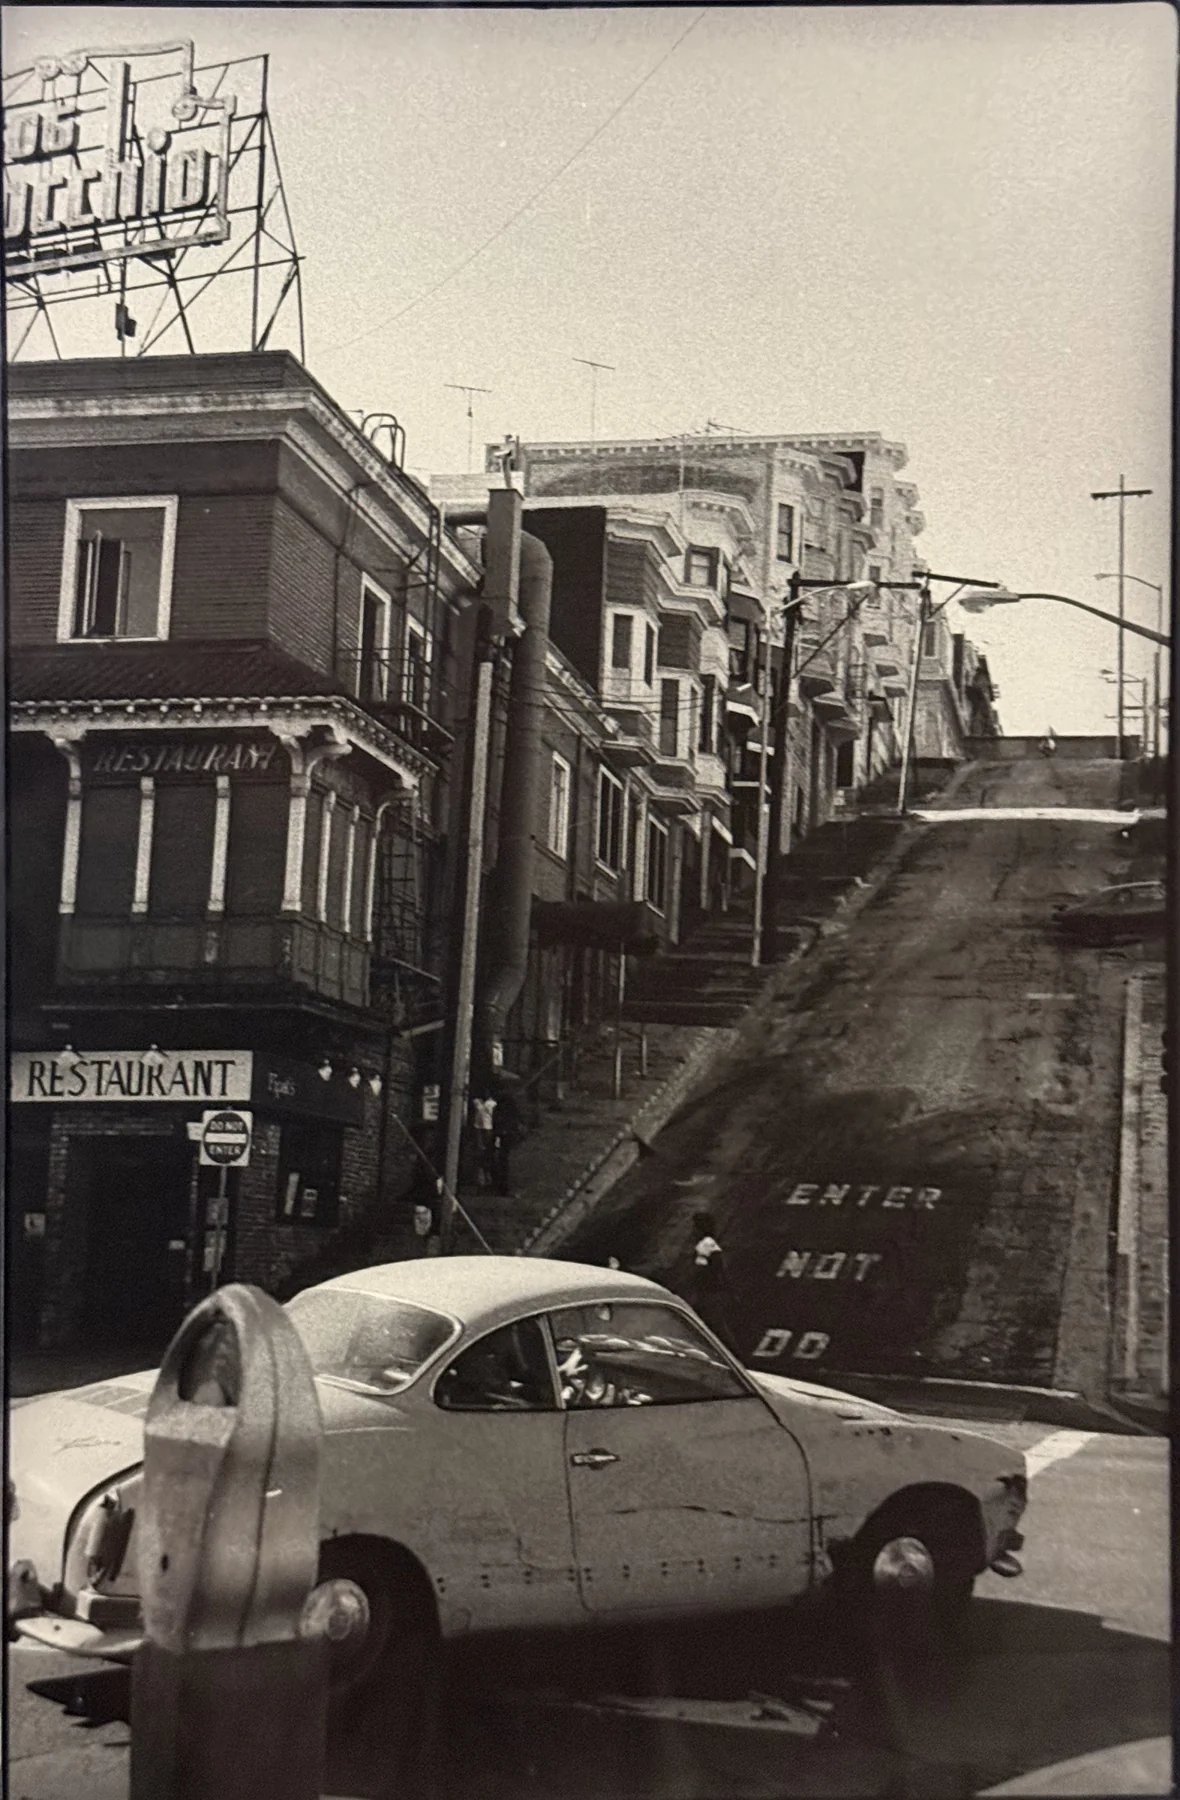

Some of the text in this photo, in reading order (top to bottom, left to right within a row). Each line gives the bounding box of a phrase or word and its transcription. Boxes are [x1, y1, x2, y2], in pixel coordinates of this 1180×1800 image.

[27, 1060, 236, 1096] RESTAURANT
[210, 1120, 243, 1131] DO NOT
[209, 1145, 241, 1155] ENTER
[786, 1183, 942, 1209] ENTER
[776, 1250, 882, 1281] NOT
[752, 1328, 830, 1359] DO
